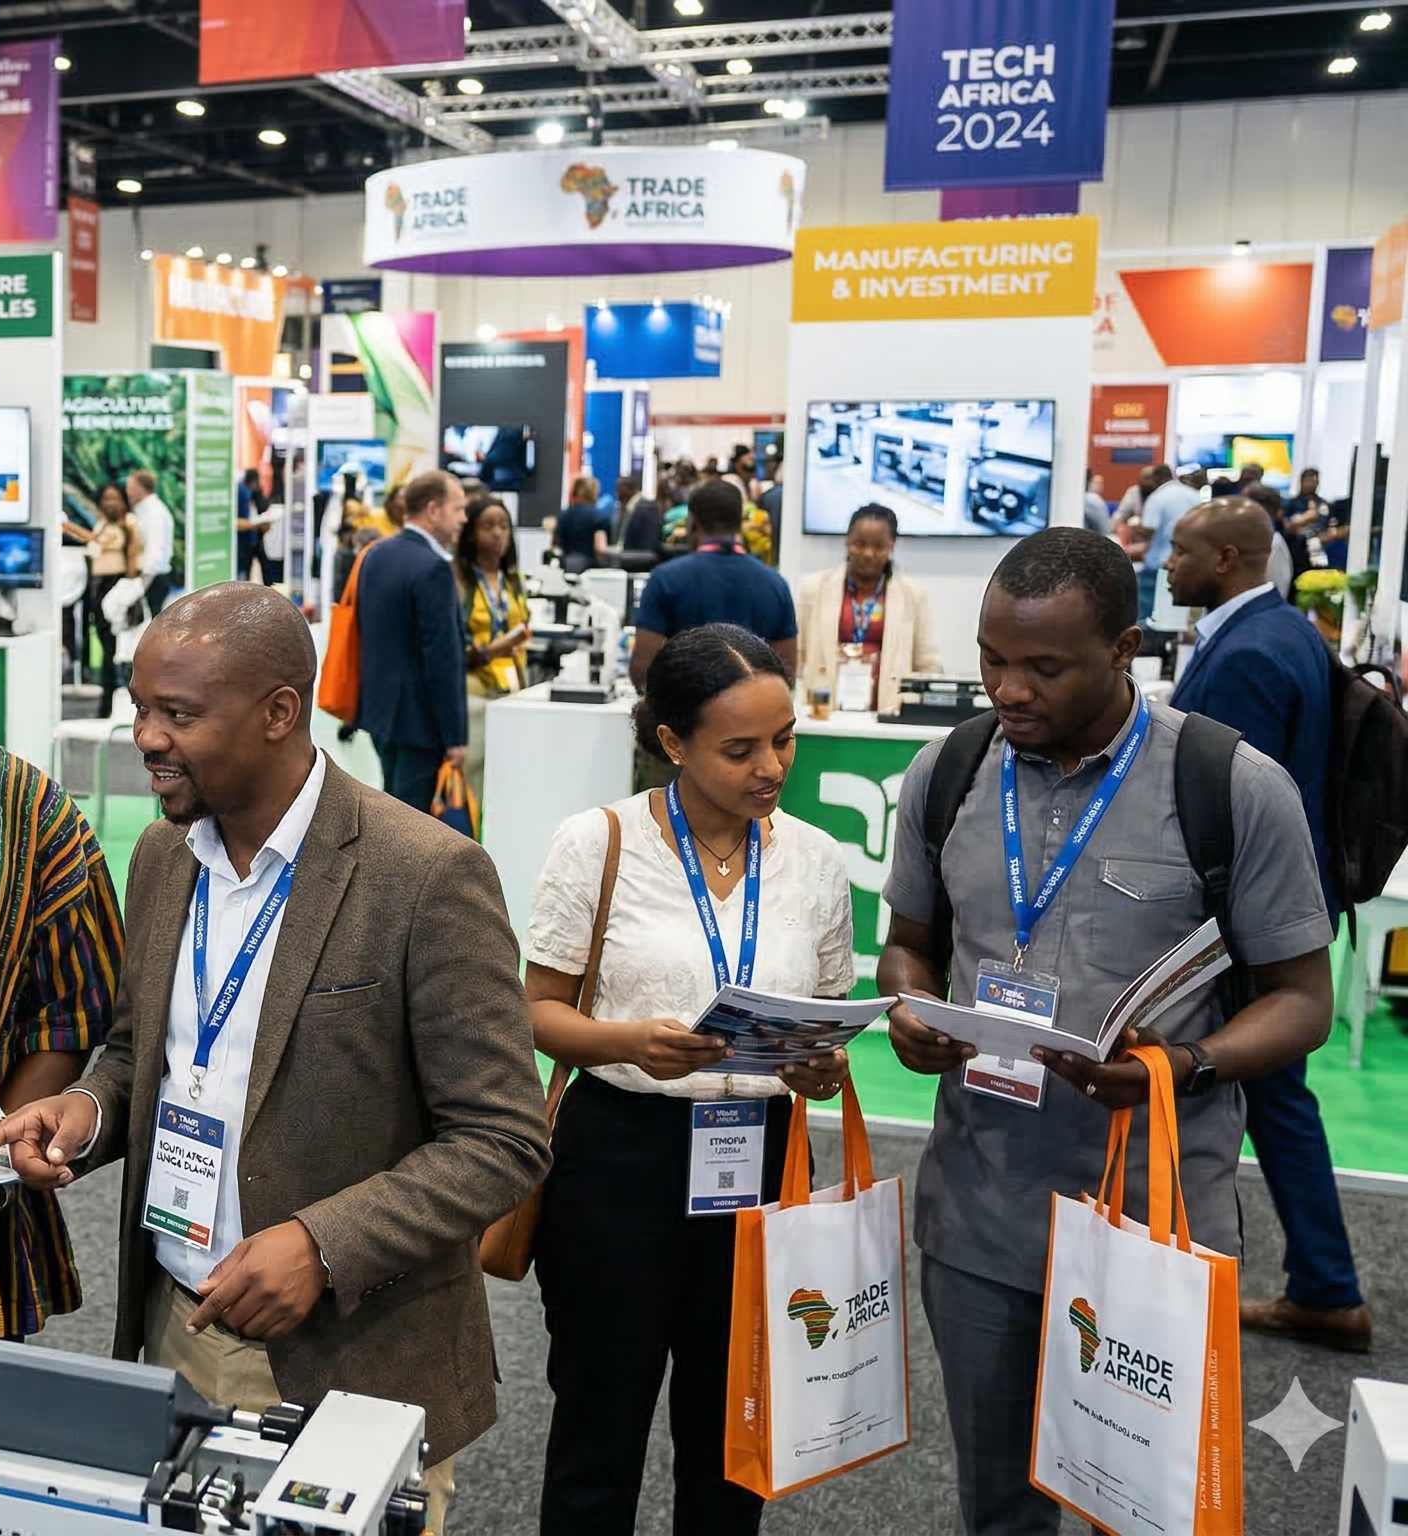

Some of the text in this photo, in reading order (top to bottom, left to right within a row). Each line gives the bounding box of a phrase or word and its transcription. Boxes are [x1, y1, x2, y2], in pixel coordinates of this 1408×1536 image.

[942, 44, 1055, 81] TECH
[938, 79, 1056, 110] AFRICA
[936, 109, 1055, 152] 2024
[412, 187, 468, 209] TRADE
[626, 177, 704, 197] TRADE
[412, 210, 468, 229] AFRICA
[625, 201, 704, 219] AFRICA
[814, 241, 1073, 271] MANUFACTURING
[832, 271, 1052, 299] & INVESTMENT
[845, 1280, 889, 1314] TRADE
[846, 1299, 890, 1333] AFRICA
[1105, 1336, 1173, 1381] TRADE
[1104, 1359, 1172, 1404] AFRICA
